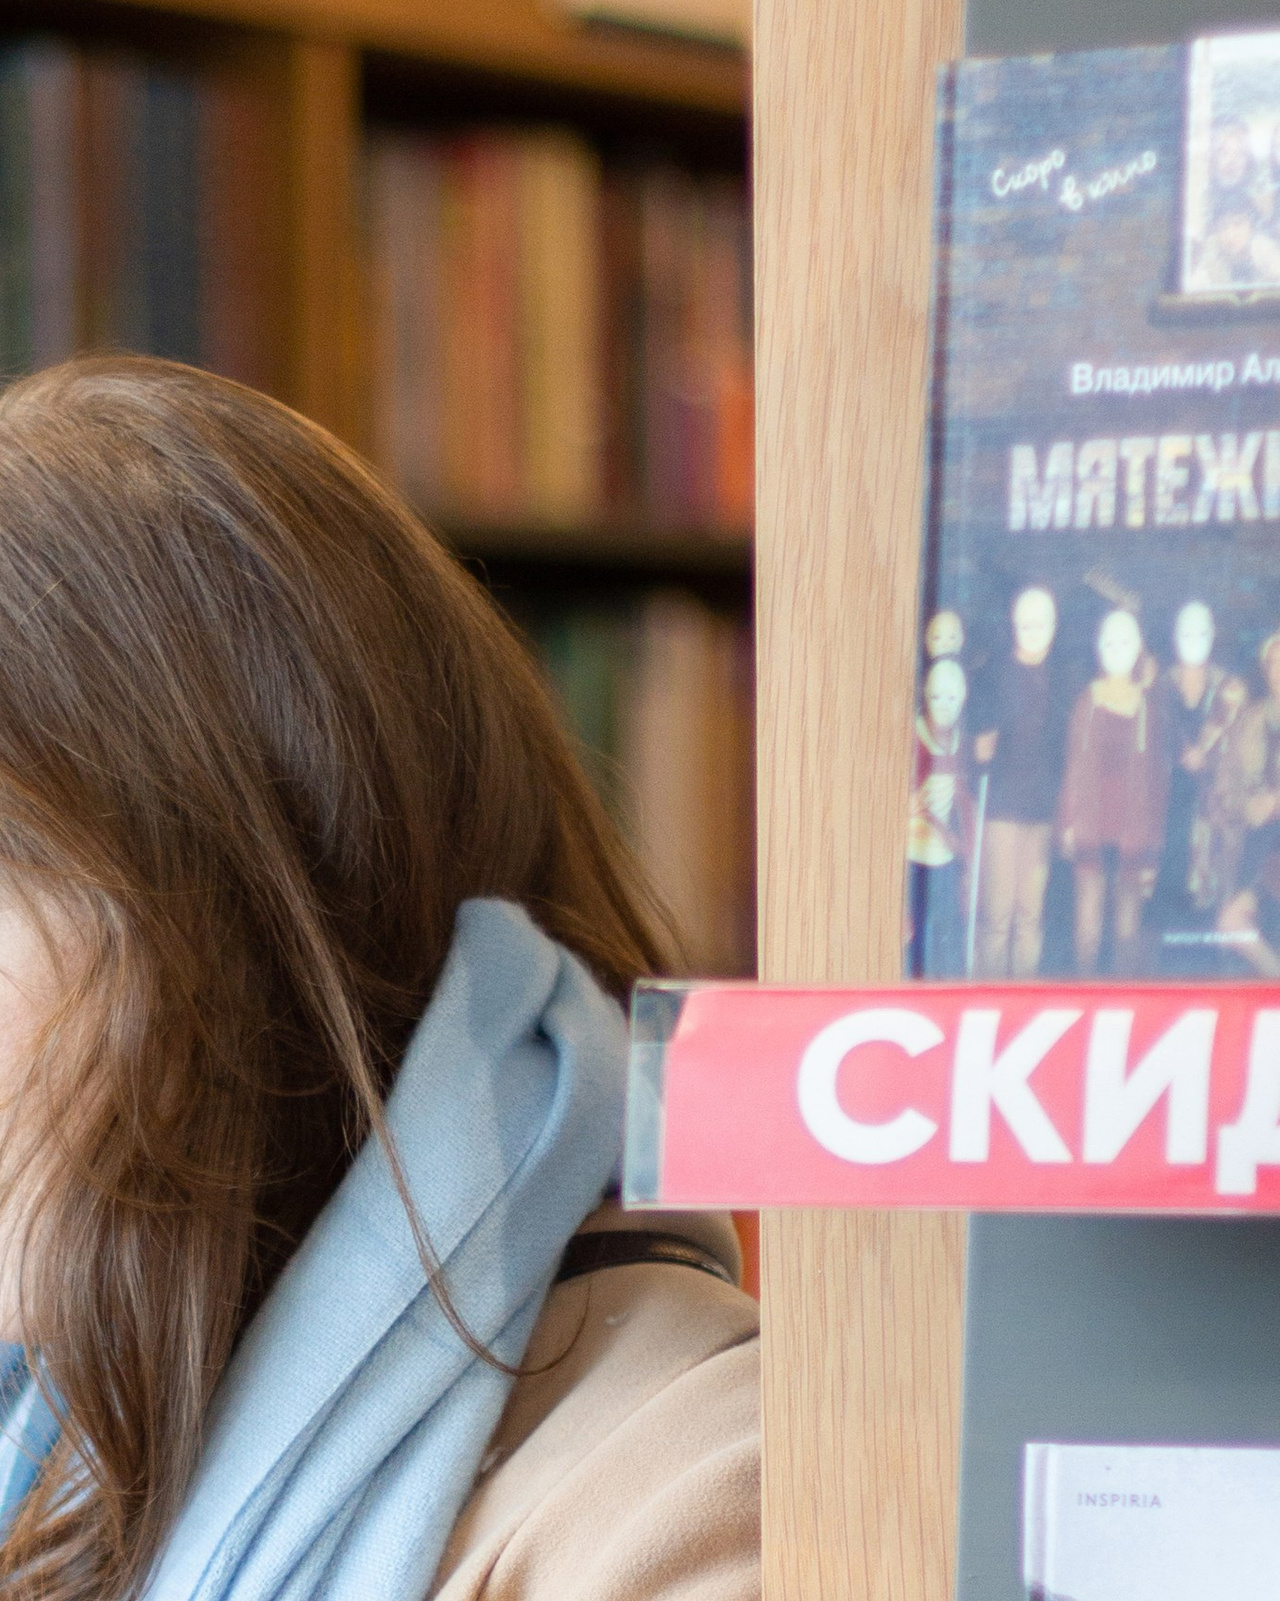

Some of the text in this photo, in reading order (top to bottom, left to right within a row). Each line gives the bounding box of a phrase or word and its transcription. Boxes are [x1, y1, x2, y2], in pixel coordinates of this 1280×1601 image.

[992, 149, 1065, 197] Скоро
[1088, 150, 1156, 198] кино
[1071, 361, 1235, 394] Владимир
[1077, 1493, 1162, 1508] INSPIRIA
